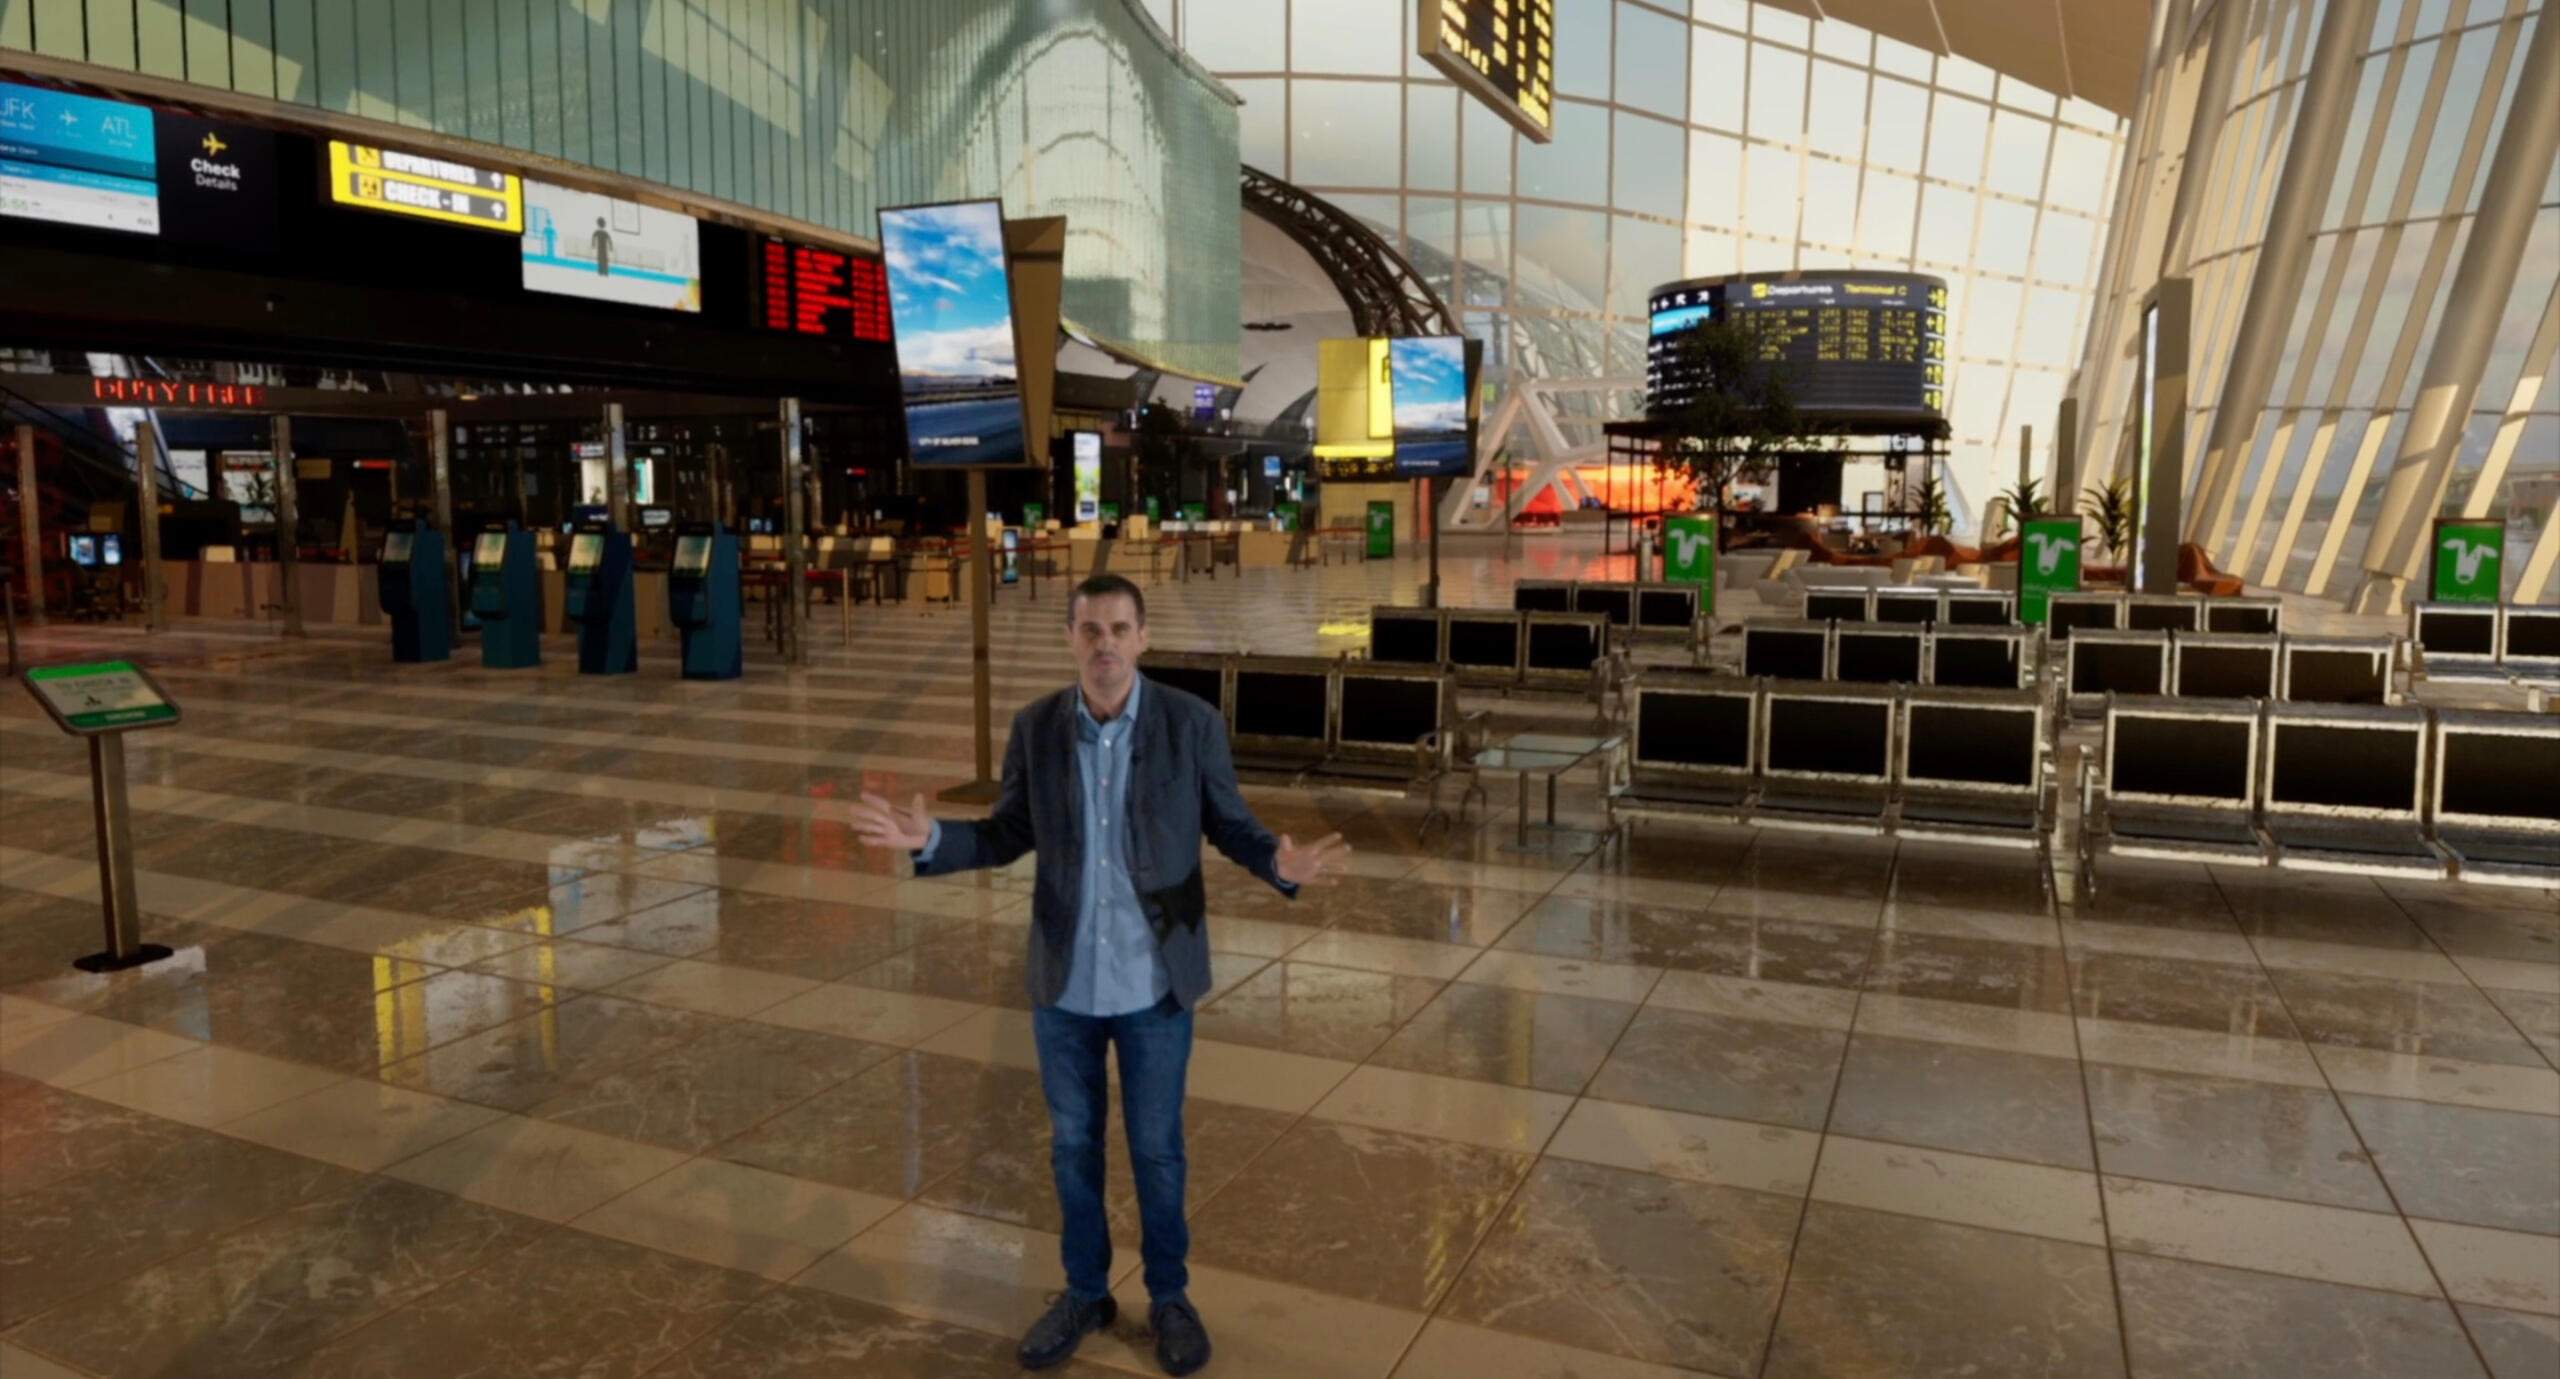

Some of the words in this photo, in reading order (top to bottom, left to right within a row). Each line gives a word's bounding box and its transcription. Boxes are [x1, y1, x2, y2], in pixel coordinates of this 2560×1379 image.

[0, 98, 36, 120] JFK
[102, 116, 138, 140] ATL
[191, 158, 241, 179] Check
[383, 151, 477, 184] DEPARTURES
[195, 173, 238, 191] Details
[385, 181, 442, 209] CHECK
[452, 193, 470, 214] IN
[1769, 284, 1833, 296] Departures
[1845, 284, 1895, 296] Terminal
[1898, 286, 1907, 296] C
[94, 378, 181, 402] DUTY
